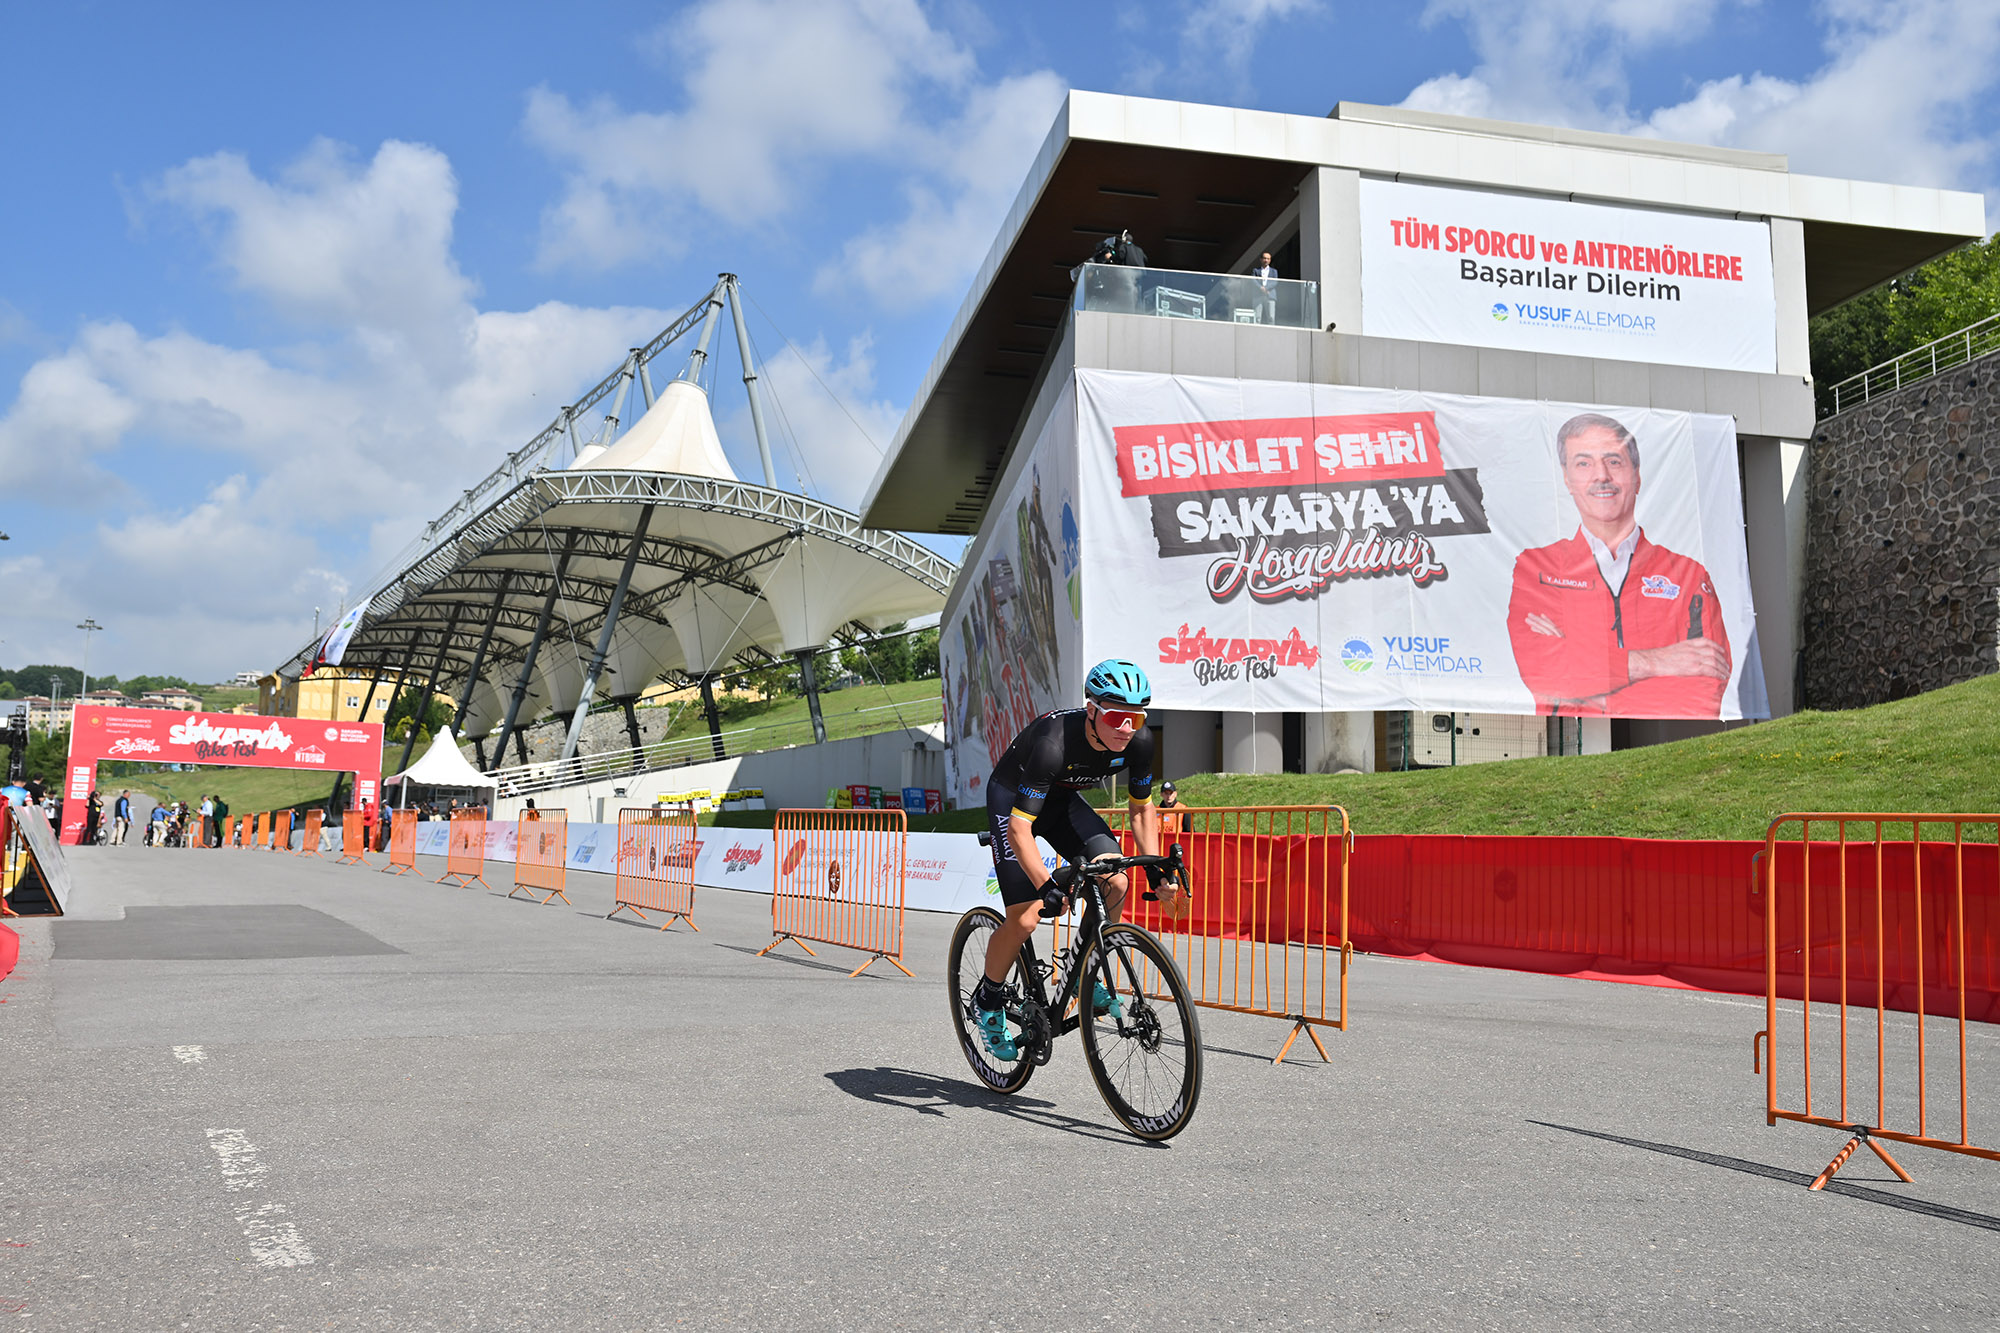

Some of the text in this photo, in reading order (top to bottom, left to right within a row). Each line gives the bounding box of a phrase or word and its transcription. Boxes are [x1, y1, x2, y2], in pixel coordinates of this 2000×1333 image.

[1390, 217, 1743, 281] TÜM SPORCU ve ANTRENÖRLERE
[1461, 258, 1681, 301] Başarılar Dilerim
[1515, 303, 1656, 331] YUSUF ALEMDAR
[1314, 422, 1428, 476] ŞEHRİ
[1158, 632, 1319, 669] SAKARYA
[1382, 636, 1450, 653] YUSUF
[1194, 658, 1239, 686] Bike
[1386, 655, 1482, 673] ALEMDAR
[169, 720, 292, 750] SAKARYA
[195, 740, 229, 760] Bike
[939, 860, 947, 869] VE
[970, 914, 998, 929] MIC
[1087, 931, 1140, 976] MCHE
[964, 1040, 1009, 1088] MICHE
[1128, 1094, 1184, 1132] MICHE
